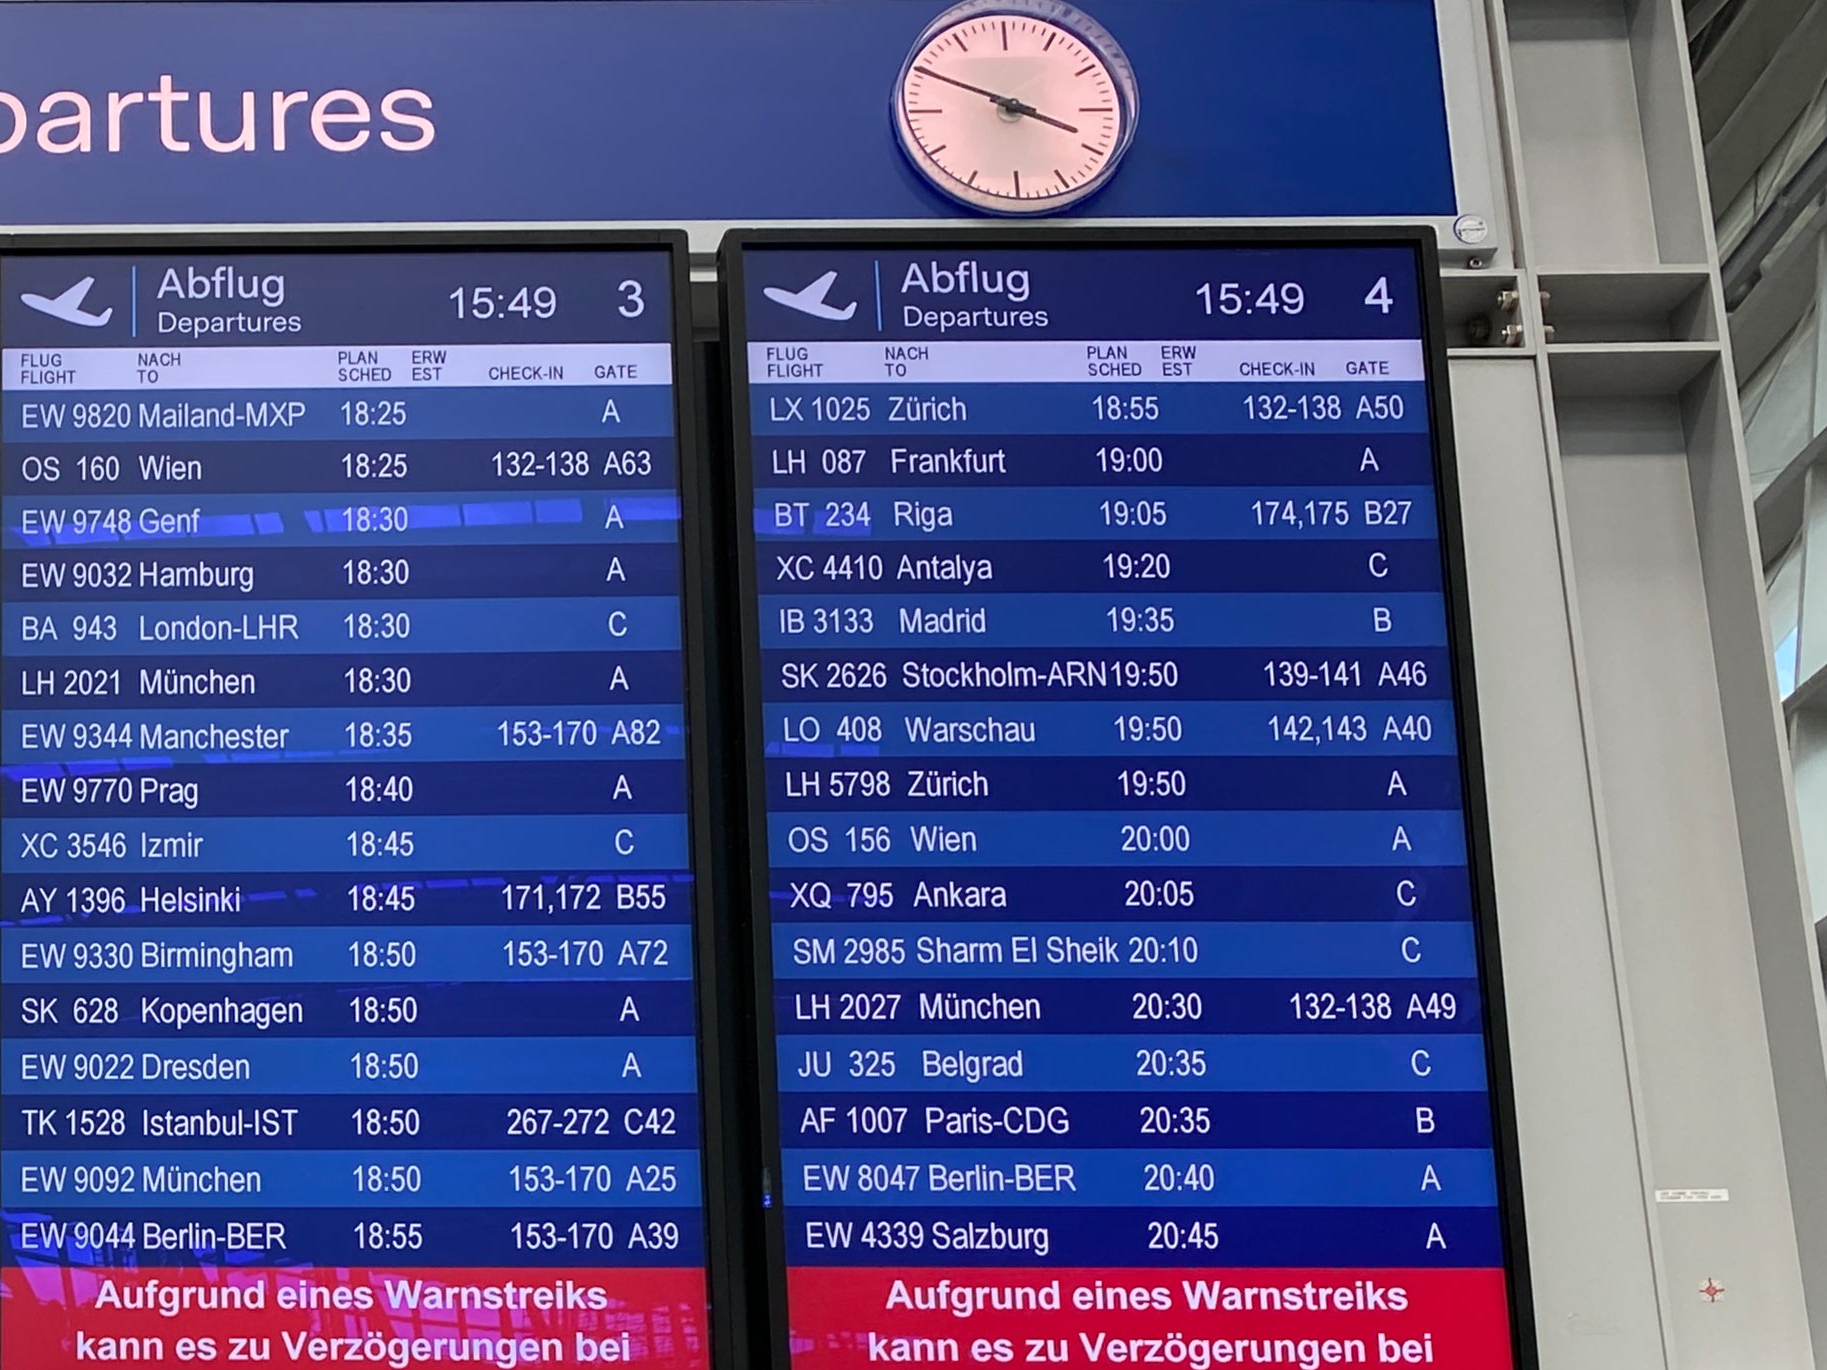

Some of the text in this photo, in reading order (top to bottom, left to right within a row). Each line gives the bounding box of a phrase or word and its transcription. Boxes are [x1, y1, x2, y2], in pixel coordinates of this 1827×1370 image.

[157, 266, 644, 318] Abflug 15:49 3
[901, 261, 1392, 314] Abflug 15:49 4
[159, 312, 301, 338] Departures
[904, 307, 1048, 332] Departures
[22, 399, 620, 428] EW 9820 Mailand-MXP 18:25 A
[775, 500, 1411, 532] BT 234 Riga 19:05 174,175 B27
[23, 557, 625, 592] EW 9032 Hamburg 18:30 A
[23, 719, 660, 749] EW 9344 Manchester 18:35 153-170 A82
[784, 715, 1431, 745] LO 408 Warschau 19:50 142,143 A40
[21, 884, 665, 913] AY 1396 Helsinki 18:45 171,172 B55
[794, 936, 1421, 964] SM 2985 Sharm El Sheik 20:10 C
[804, 1164, 1441, 1191] EW 8047 Berlin-BER 20:40 A
[886, 1280, 1408, 1317] Aufgrund eines Warnstreiks
[869, 1332, 1432, 1370] kann es zu Verzögerungen bei
